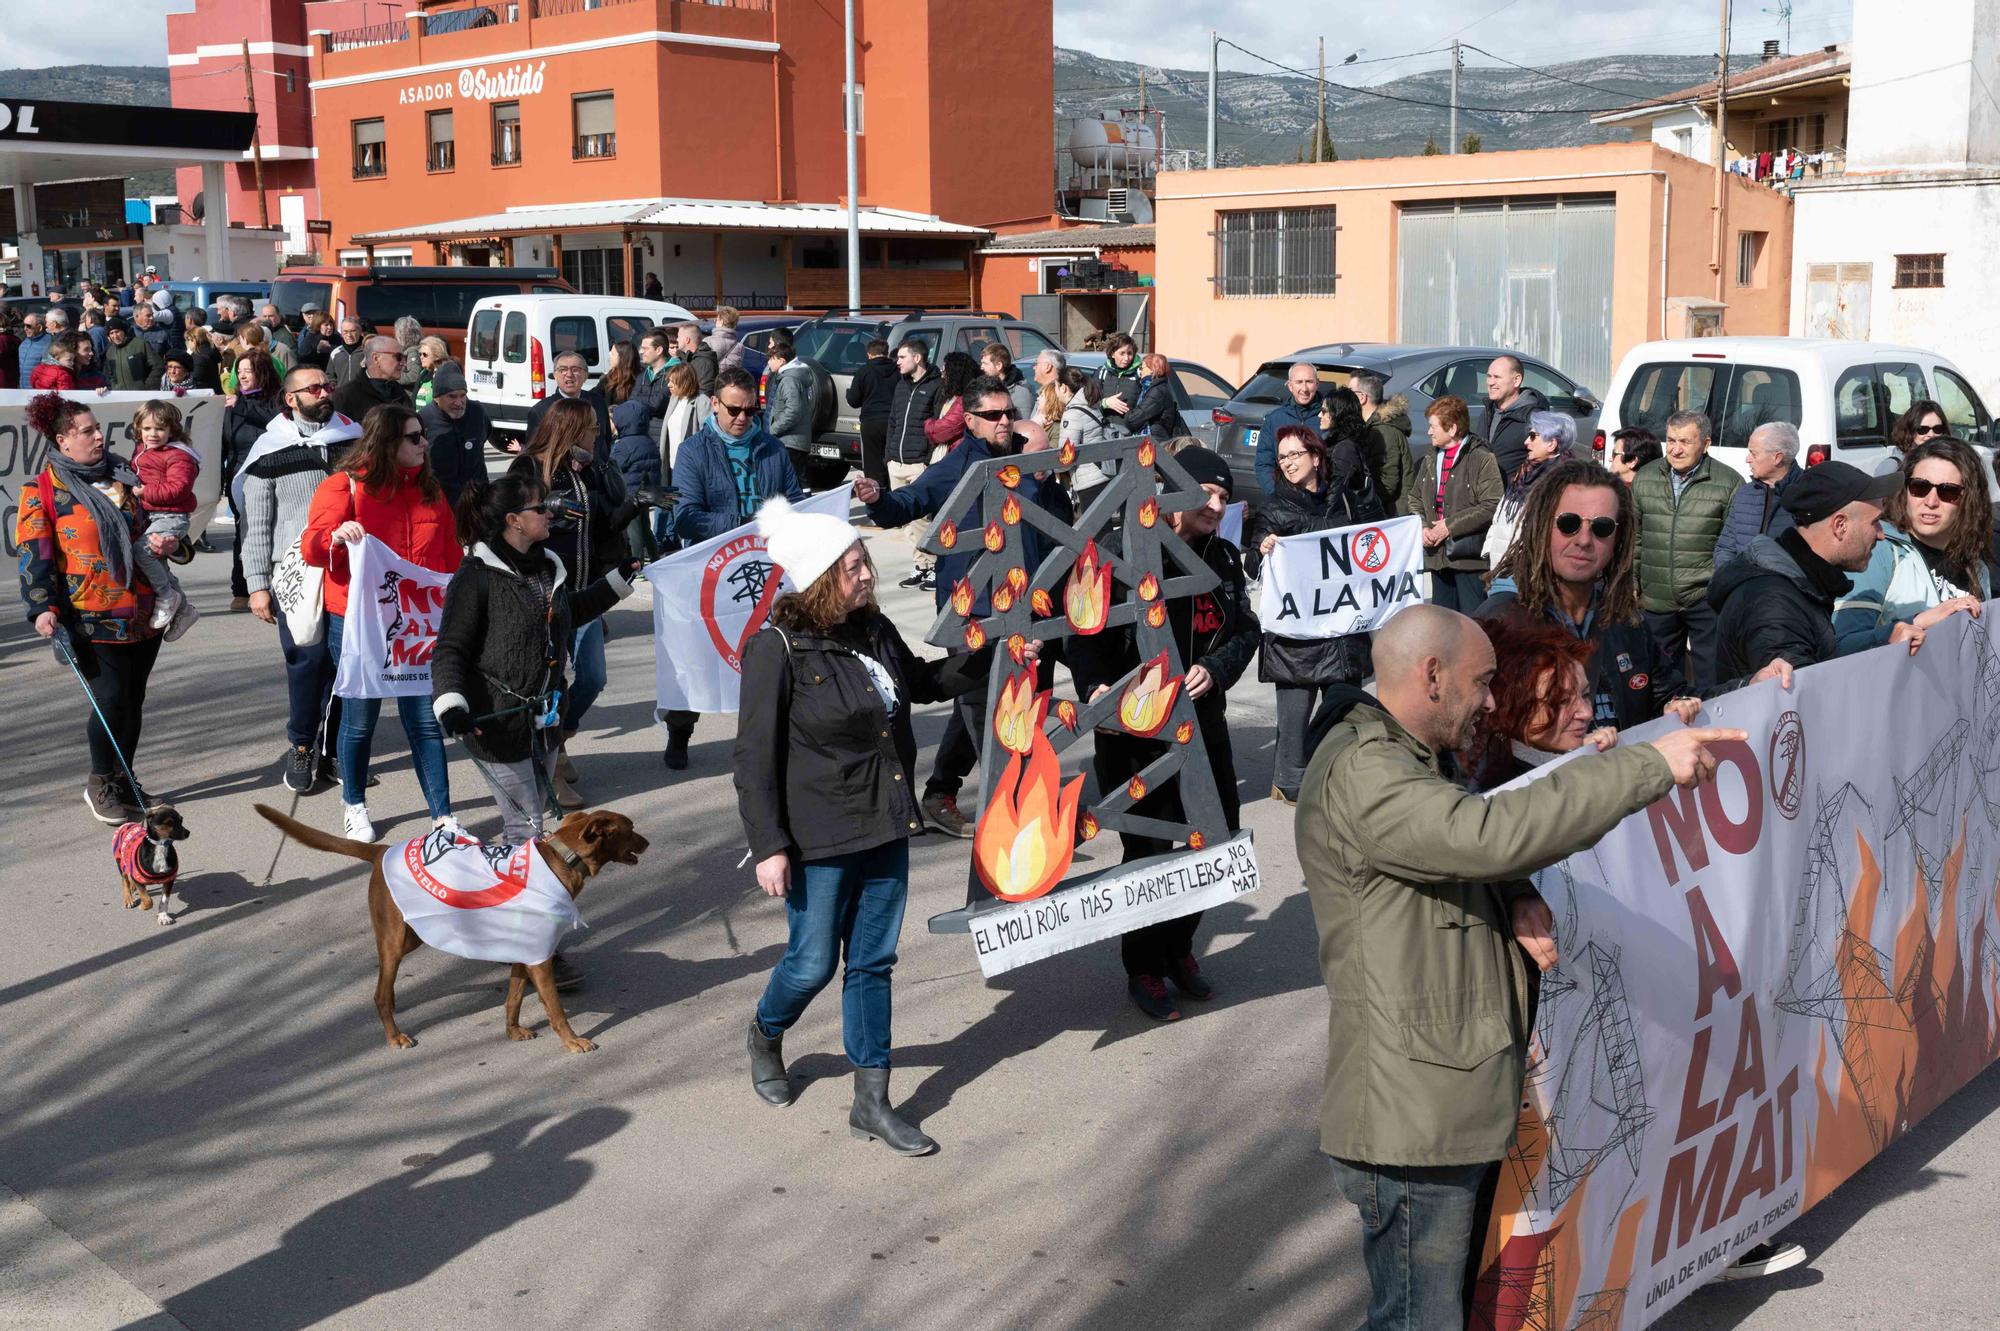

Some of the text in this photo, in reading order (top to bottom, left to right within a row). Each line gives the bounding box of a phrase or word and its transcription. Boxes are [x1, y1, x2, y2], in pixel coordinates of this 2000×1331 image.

[400, 82, 453, 104] ASADOR
[474, 61, 546, 100] Surtidó
[709, 555, 724, 572] NO
[725, 546, 736, 559] A
[734, 539, 751, 553] LA
[1276, 568, 1424, 620] A LA MA
[401, 618, 439, 637] A L
[392, 638, 437, 667] MA
[381, 672, 430, 682] COMARQUES DE
[1645, 740, 1763, 887] NO
[1228, 844, 1246, 860] NO
[1228, 858, 1256, 878] A LA
[1232, 873, 1257, 893] MAT
[975, 928, 998, 955] EL
[1124, 858, 1225, 907] D'ARMETLERS
[1685, 885, 1741, 1021] A
[1674, 992, 1766, 1145] LA
[1651, 1064, 1799, 1267] MAT
[1678, 1260, 1695, 1285] DE
[1697, 1238, 1731, 1272] MOLT
[1731, 1220, 1759, 1250] ALTA
